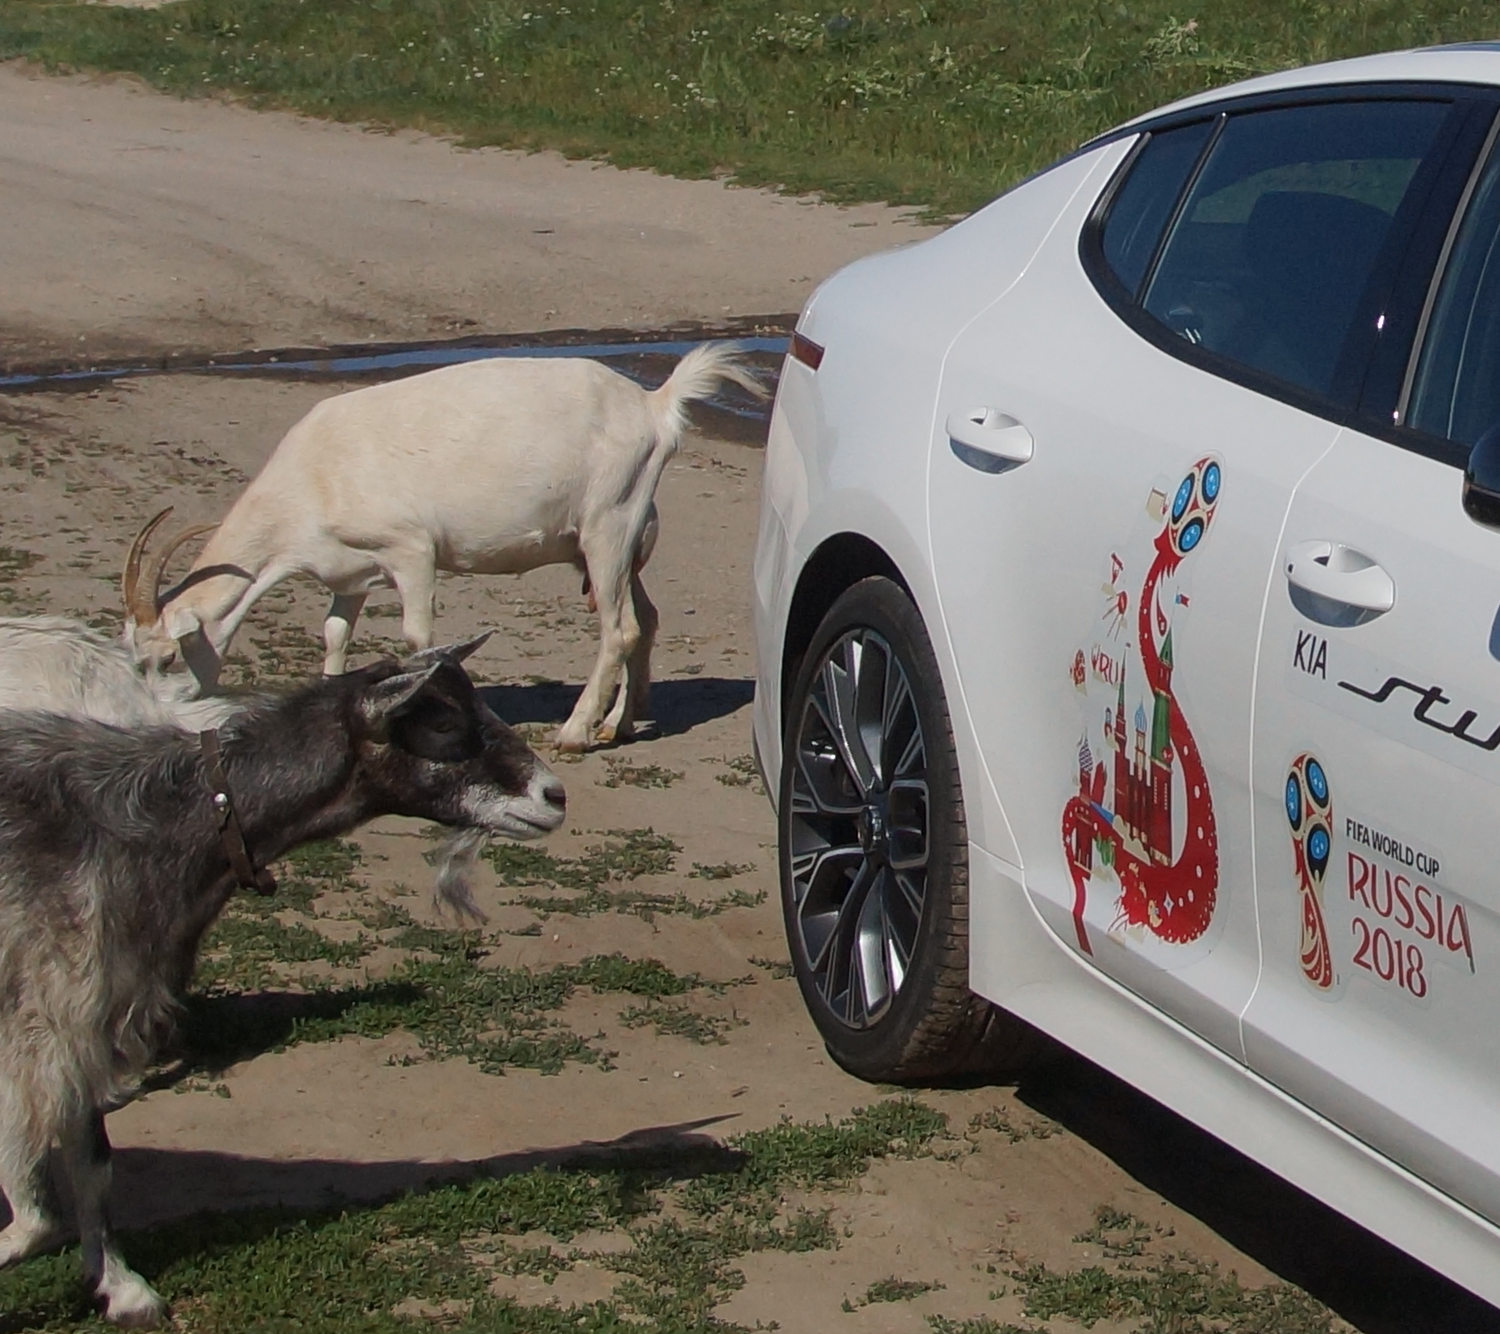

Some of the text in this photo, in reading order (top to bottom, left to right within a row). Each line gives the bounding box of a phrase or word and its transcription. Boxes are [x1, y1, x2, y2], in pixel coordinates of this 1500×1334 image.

[1293, 629, 1328, 681] KIA
[1346, 818, 1440, 878] FIFA WORLD CUP
[1348, 851, 1476, 975] RUSSIA
[1352, 917, 1427, 998] 2018
